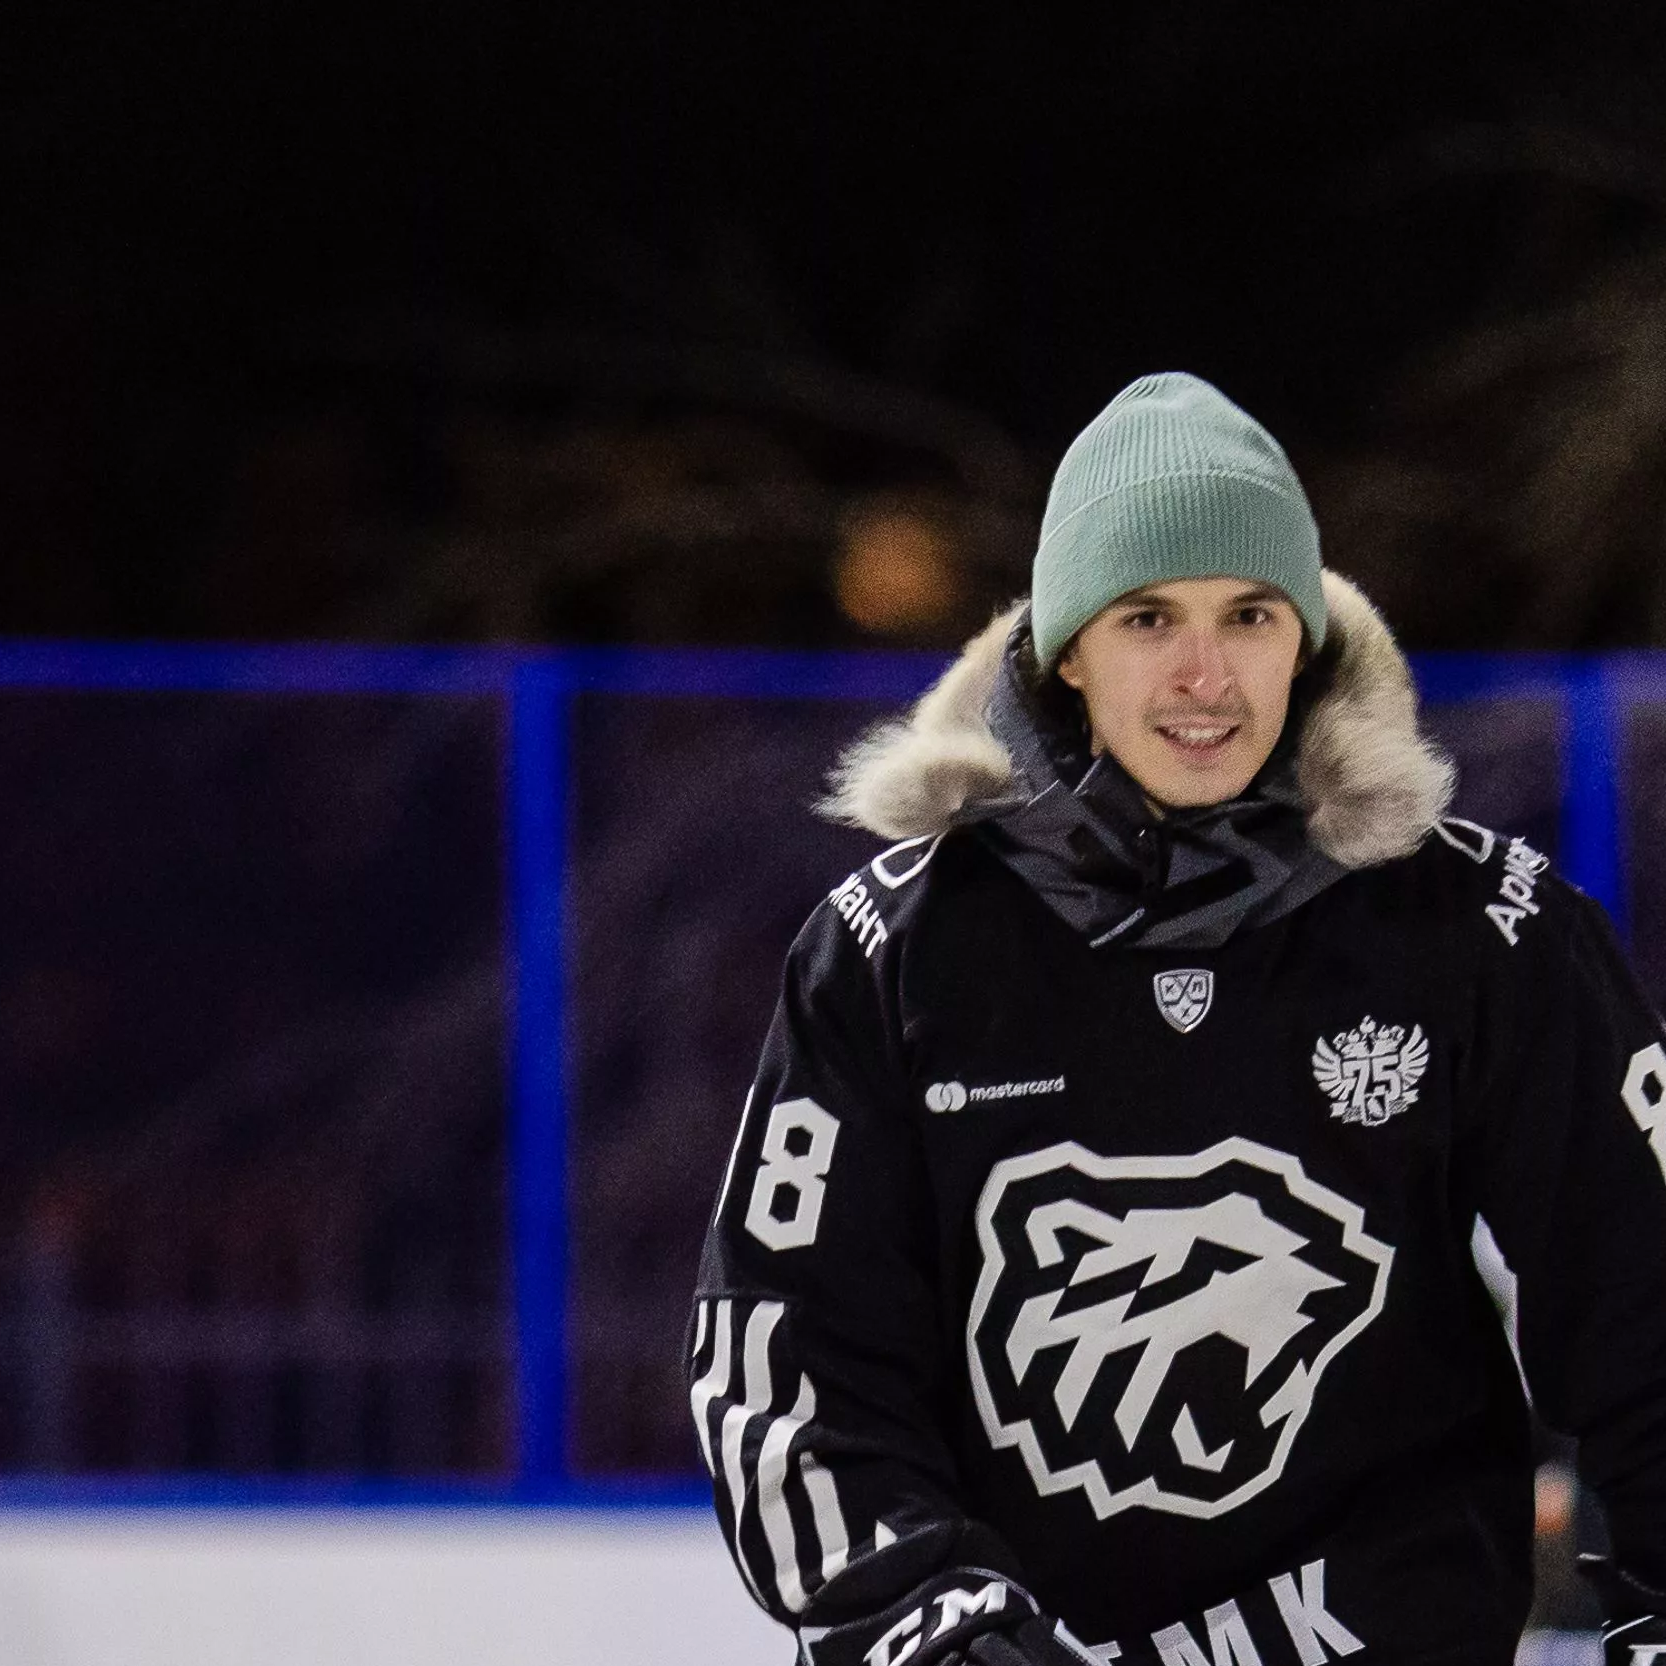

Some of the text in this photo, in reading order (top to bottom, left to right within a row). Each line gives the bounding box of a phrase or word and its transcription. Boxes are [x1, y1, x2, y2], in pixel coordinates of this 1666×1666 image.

[969, 1074, 1066, 1102] mastercard
[1340, 1052, 1402, 1107] 75
[714, 1083, 841, 1252] 8
